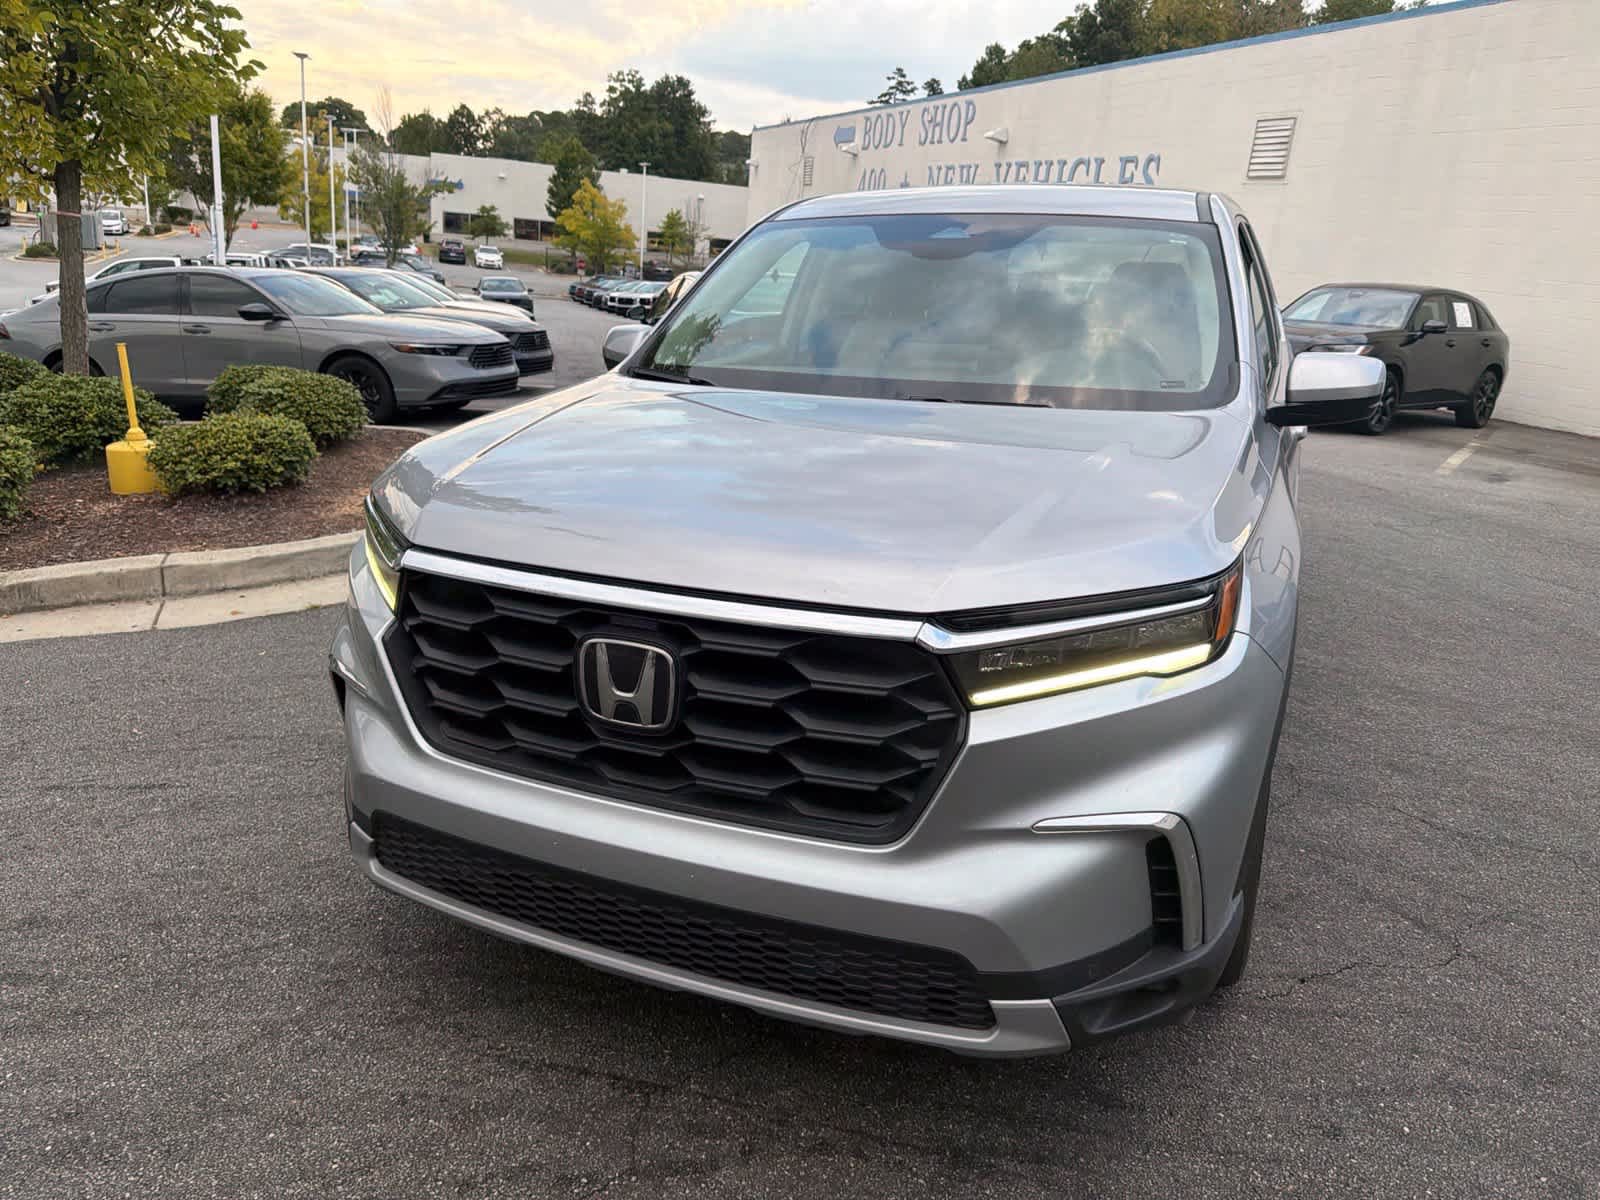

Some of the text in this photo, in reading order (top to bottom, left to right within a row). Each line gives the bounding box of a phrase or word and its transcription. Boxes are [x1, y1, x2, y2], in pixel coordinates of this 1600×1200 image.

[861, 100, 977, 151] BODY SHOP
[927, 162, 979, 185] NEW
